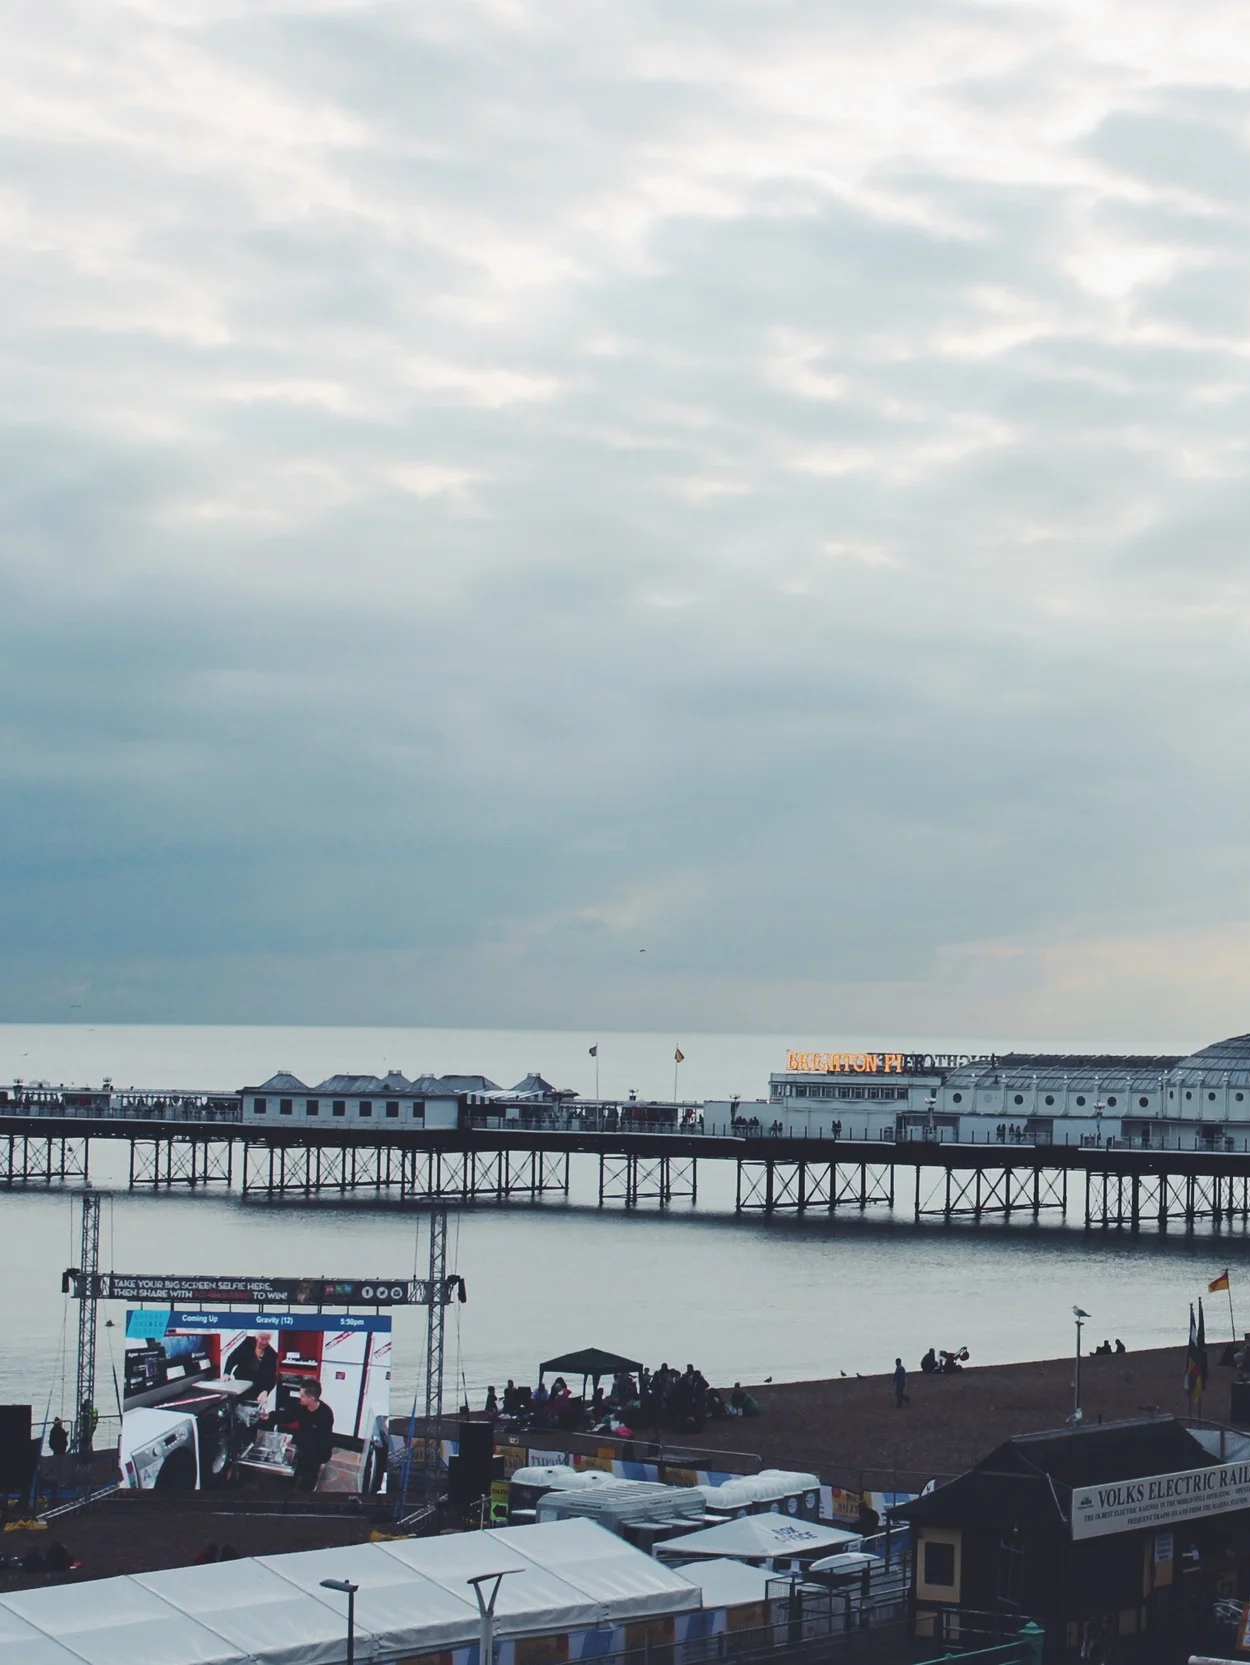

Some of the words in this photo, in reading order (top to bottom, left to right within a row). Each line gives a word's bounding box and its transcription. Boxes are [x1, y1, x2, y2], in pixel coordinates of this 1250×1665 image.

[787, 1052, 877, 1072] BRIGHTON
[114, 1279, 136, 1288] TAKE
[138, 1280, 163, 1289] YOUR
[165, 1280, 180, 1289] BIG
[181, 1281, 216, 1290] SCREEN
[218, 1281, 246, 1290] SELFIE
[247, 1282, 273, 1291] HERE.
[113, 1288, 137, 1297] THEN
[139, 1289, 168, 1298] SHARE
[170, 1290, 193, 1298] WITH
[253, 1291, 265, 1300] TO
[267, 1291, 288, 1300] WIN!
[182, 1314, 208, 1324] Coming
[209, 1315, 218, 1323] Up
[256, 1316, 279, 1324] Gravity
[280, 1317, 294, 1326] (12)
[1098, 1484, 1144, 1509] VOLKS
[1148, 1472, 1215, 1500] ELECTRIC
[771, 1526, 799, 1536] BOX
